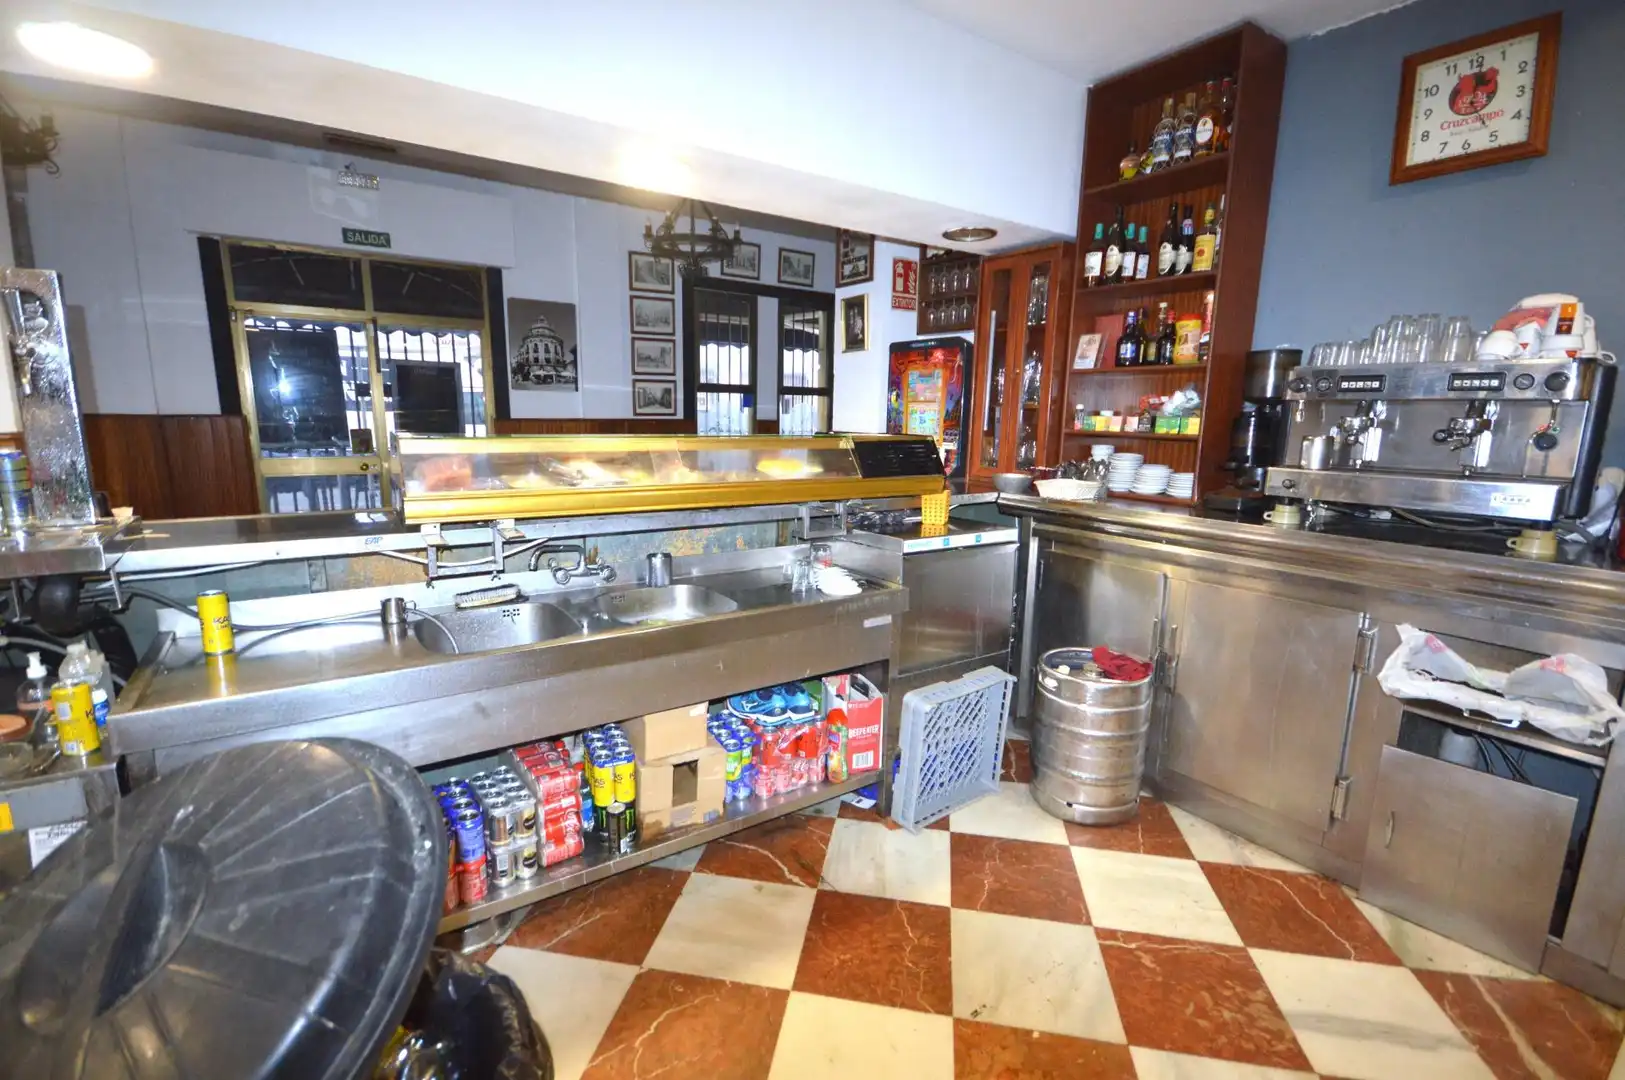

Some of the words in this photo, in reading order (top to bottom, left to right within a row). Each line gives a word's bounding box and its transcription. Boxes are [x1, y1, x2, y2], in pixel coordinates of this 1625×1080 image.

[1500, 50, 1506, 61] 1
[1445, 63, 1458, 76] 11
[1468, 56, 1484, 70] 12
[1517, 61, 1528, 75] 2
[1423, 84, 1440, 98] 10
[1516, 84, 1526, 98] 3
[1424, 108, 1433, 120] 9
[1440, 109, 1504, 131] Cruzcampo
[1511, 109, 1522, 120] 4
[1420, 130, 1430, 143] 8
[1489, 130, 1499, 143] 5
[1439, 141, 1448, 154] 7
[1461, 138, 1472, 151] 6
[346, 231, 387, 246] SALIDA
[848, 724, 880, 739] BEEFEATER
